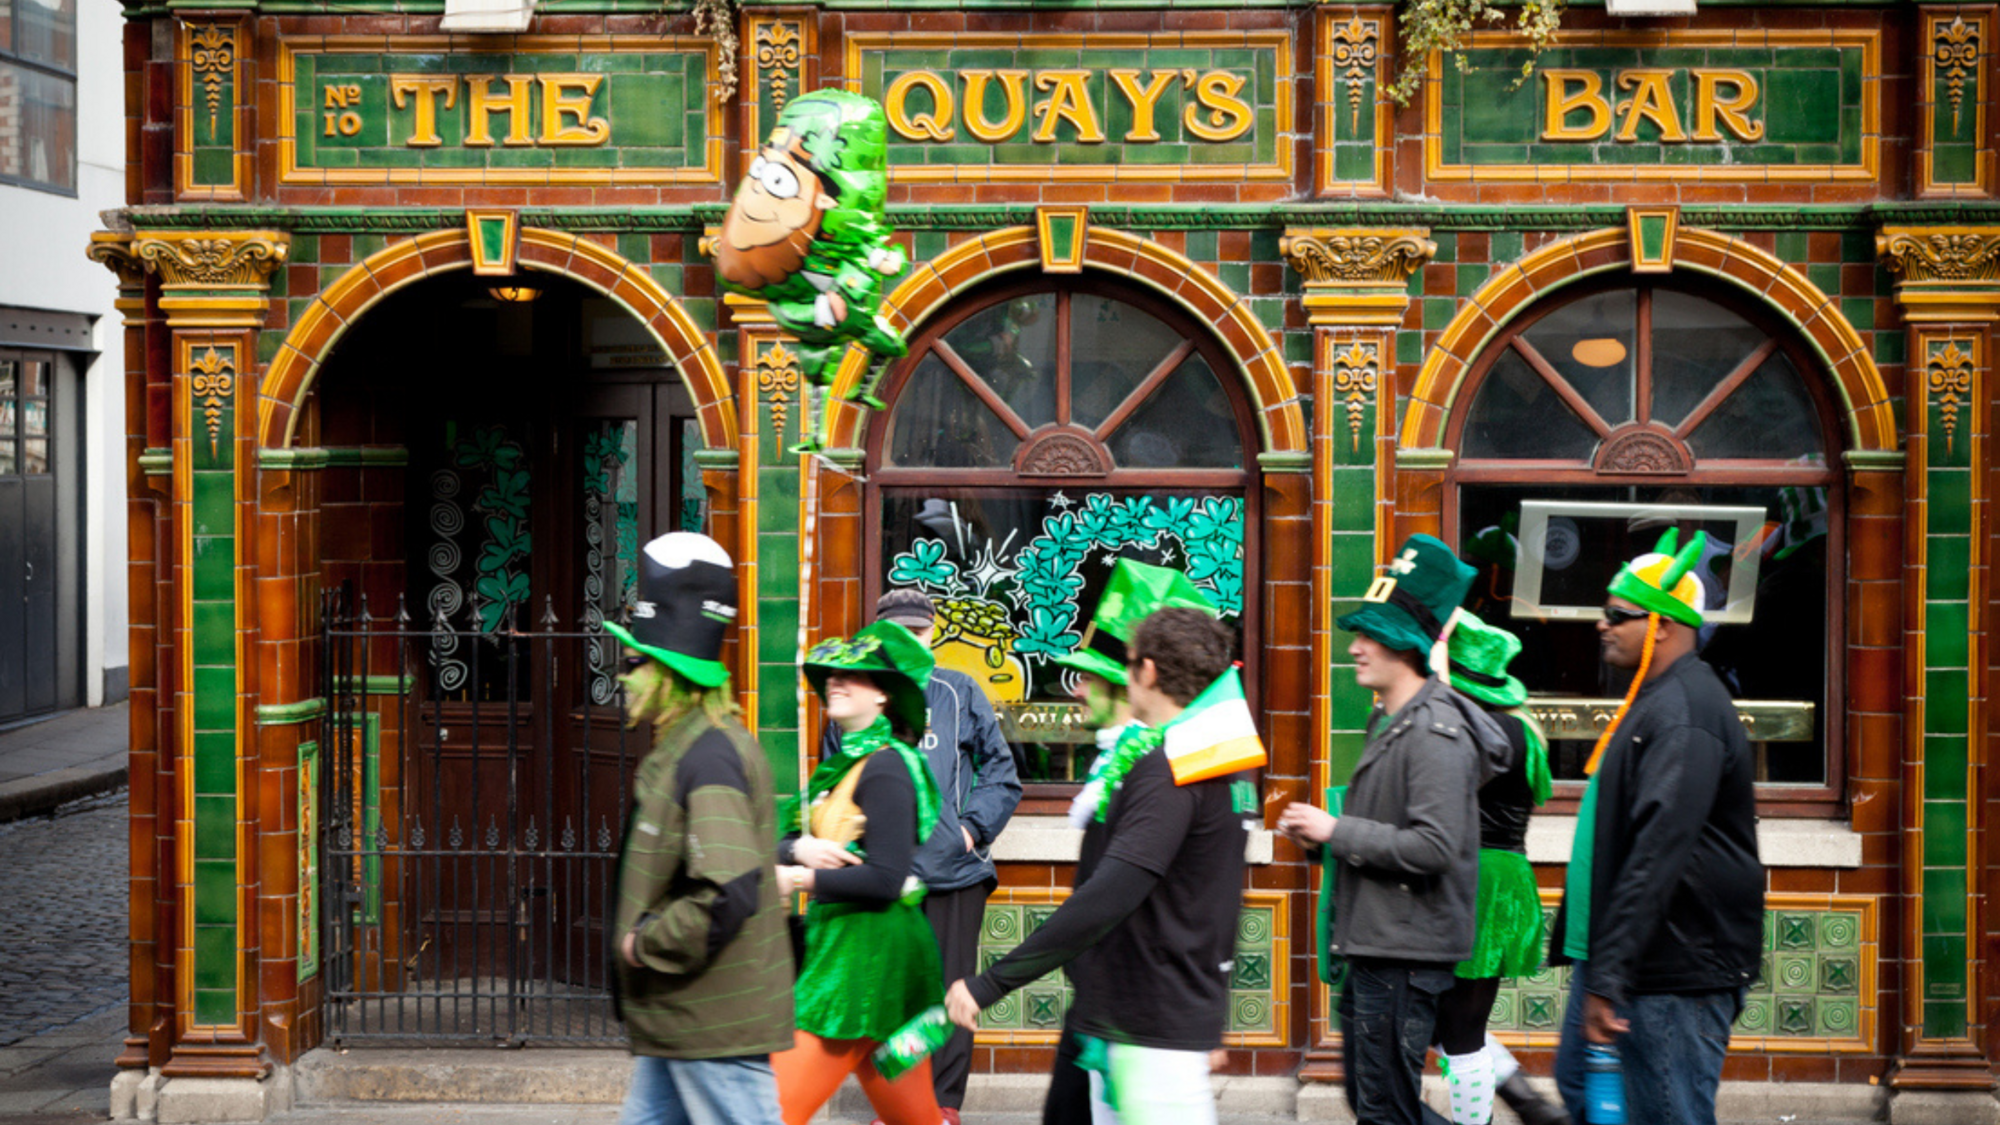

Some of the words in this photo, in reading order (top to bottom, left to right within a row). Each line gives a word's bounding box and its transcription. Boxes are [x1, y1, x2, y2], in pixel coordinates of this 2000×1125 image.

[390, 72, 611, 147] THE
[885, 69, 1254, 143] QUAY'S
[1541, 68, 1764, 142] BAR
